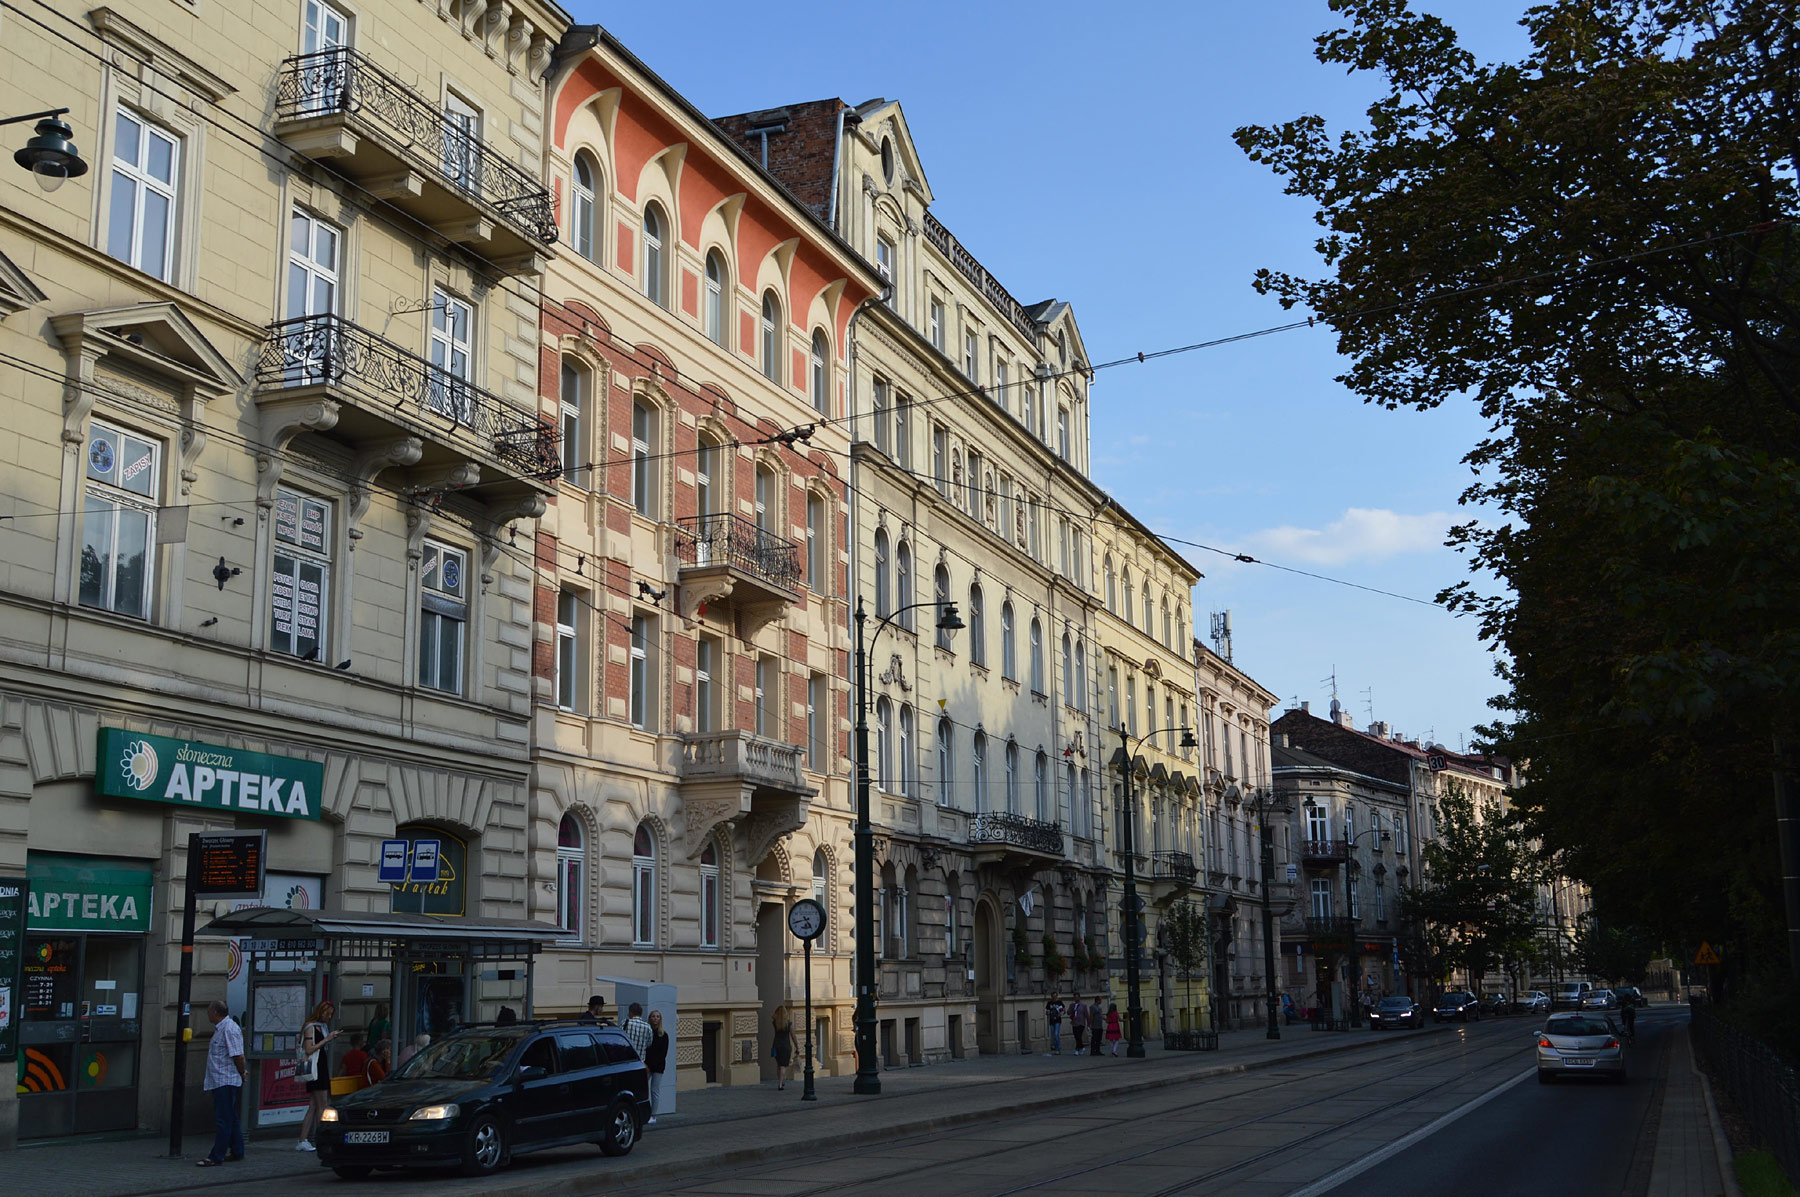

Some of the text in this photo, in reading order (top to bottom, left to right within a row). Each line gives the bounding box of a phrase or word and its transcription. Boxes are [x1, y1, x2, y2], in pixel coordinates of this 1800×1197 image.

[124, 453, 151, 480] ZAPISY
[306, 508, 320, 520] BHP
[273, 583, 292, 597] KOSM
[176, 743, 233, 768] słoneczna
[1430, 756, 1445, 769] 30
[164, 762, 310, 815] APTEKA
[28, 891, 139, 920] APTEKA
